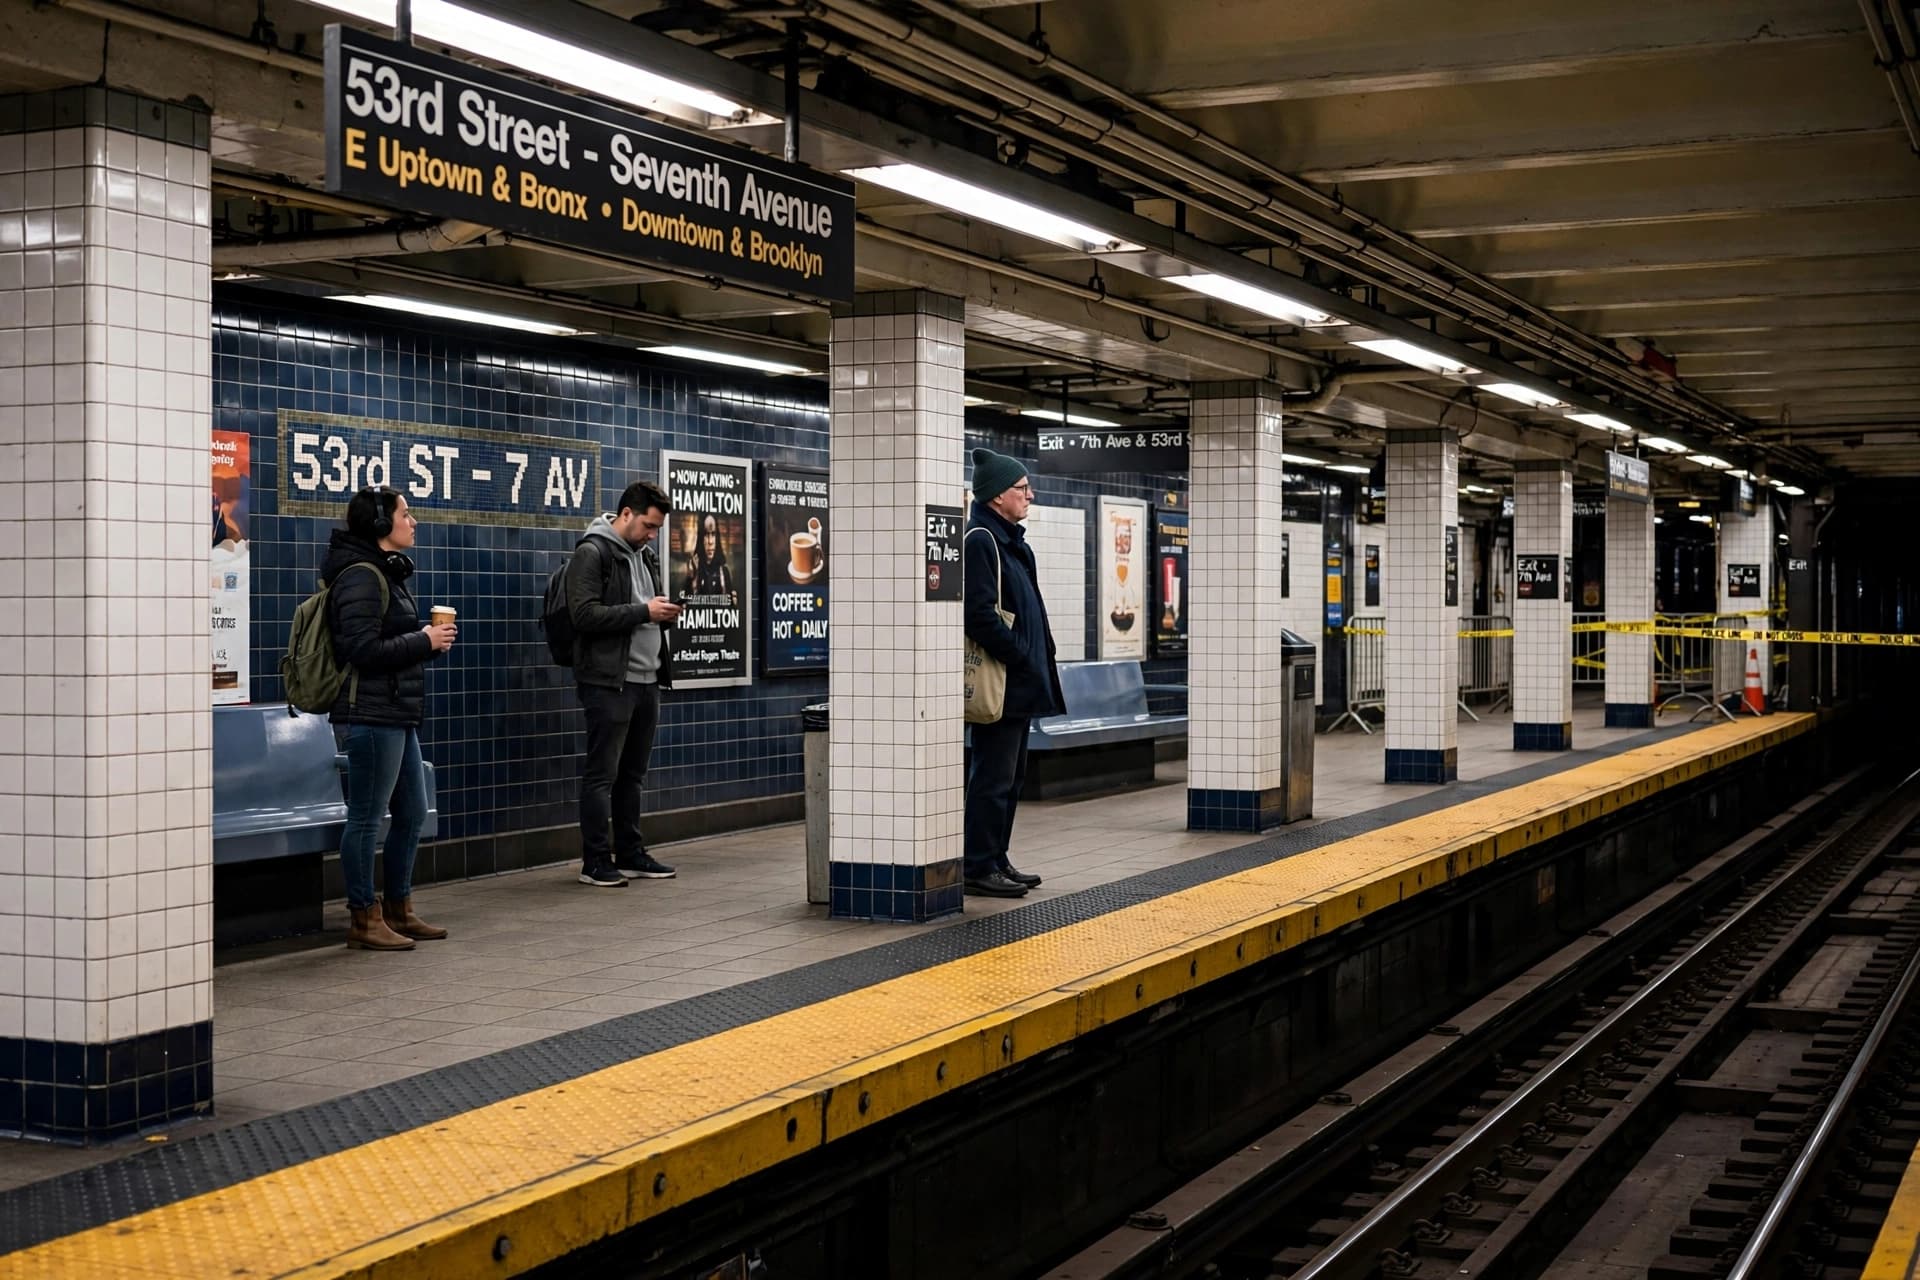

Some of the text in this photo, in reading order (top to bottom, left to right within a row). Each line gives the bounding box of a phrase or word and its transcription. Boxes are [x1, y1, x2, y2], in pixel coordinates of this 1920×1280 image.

[345, 55, 444, 136] 53rd
[457, 89, 571, 169] Street
[609, 134, 731, 212] Seventh
[740, 172, 833, 238] Avenue
[345, 129, 366, 170] E
[378, 138, 483, 197] Uptown
[491, 164, 511, 203] &
[519, 175, 589, 221] Bronx
[622, 197, 725, 254] Downtown
[729, 226, 744, 257] &
[749, 231, 824, 279] Brooklyn
[1038, 435, 1064, 450] Exit
[1080, 434, 1101, 449] 7th
[1105, 433, 1131, 448] Ave
[1135, 433, 1146, 447] &
[1151, 432, 1182, 447] 53rd
[293, 432, 391, 493] 53rd
[408, 443, 460, 501] ST
[505, 452, 529, 504] 7
[544, 456, 589, 508] AV
[676, 469, 734, 489] NOW PLAYING
[672, 488, 743, 515] HAMILTON
[926, 516, 948, 539] Exit
[927, 541, 942, 561] 7th
[772, 592, 815, 612] COFFEE
[677, 608, 740, 630] HAMILTON
[772, 619, 829, 640] HOT DAILY
